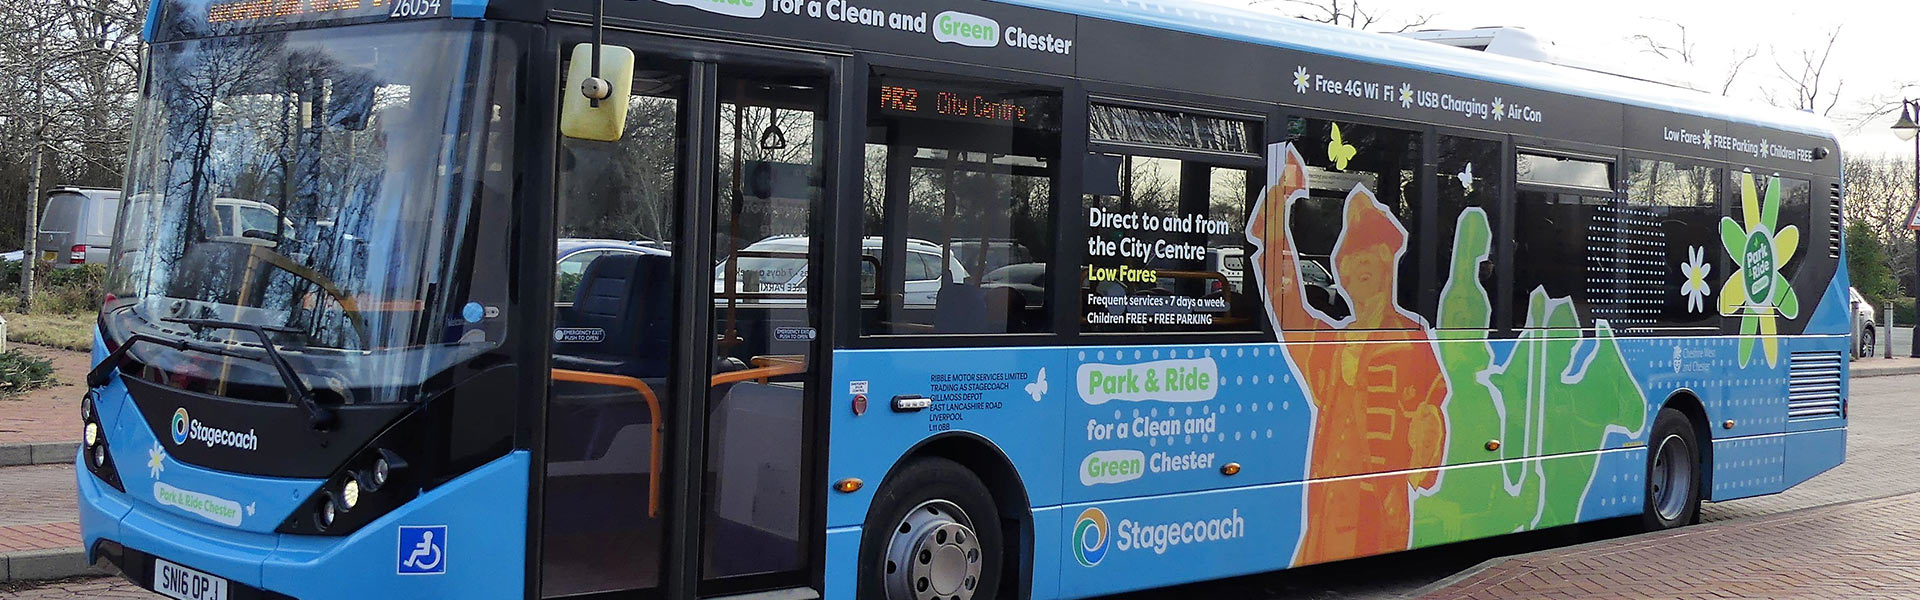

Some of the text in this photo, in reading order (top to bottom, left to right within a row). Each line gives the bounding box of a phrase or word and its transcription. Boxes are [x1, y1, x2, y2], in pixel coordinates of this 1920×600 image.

[391, 0, 441, 17] 26054
[772, 0, 1072, 55] for a Clean and Green Chester
[1315, 74, 1394, 102] Free 4G Wi Fi
[881, 85, 1026, 122] PR2 City Centre
[1417, 90, 1488, 120] USB Charging
[1507, 103, 1542, 123] Air Con
[1664, 127, 1701, 145] Low Fares
[1713, 135, 1758, 157] FREE Parking
[1769, 144, 1813, 163] Children FREE
[1089, 207, 1229, 235] Direct to and from
[1088, 236, 1206, 263] the City Centre
[1747, 243, 1768, 268] Park
[1088, 264, 1157, 283] Low Fares
[1752, 260, 1769, 280] Ride
[1088, 294, 1225, 309] Frequent services 7 days a week
[1087, 312, 1212, 325] Children FREE FREE PARKING
[931, 372, 1028, 382] RIBBLE MOTOR SERVICES LIMITED
[931, 382, 1009, 392] TRADING AS STAGECOACH
[1089, 366, 1210, 395] Park & Ride
[930, 403, 946, 411] EAST
[946, 402, 984, 411] LANCASHIRE
[931, 392, 983, 402] GILLMOSS DEPOT
[929, 413, 963, 421] LIVERPOOL
[1087, 412, 1216, 441] for a Clean and
[189, 418, 258, 451] Stagecoach
[1088, 451, 1215, 478] Green Chester
[160, 487, 237, 518] Park & Ride Chester
[1116, 508, 1244, 555] Stagecoach
[163, 565, 218, 600] SN16 OPJ
